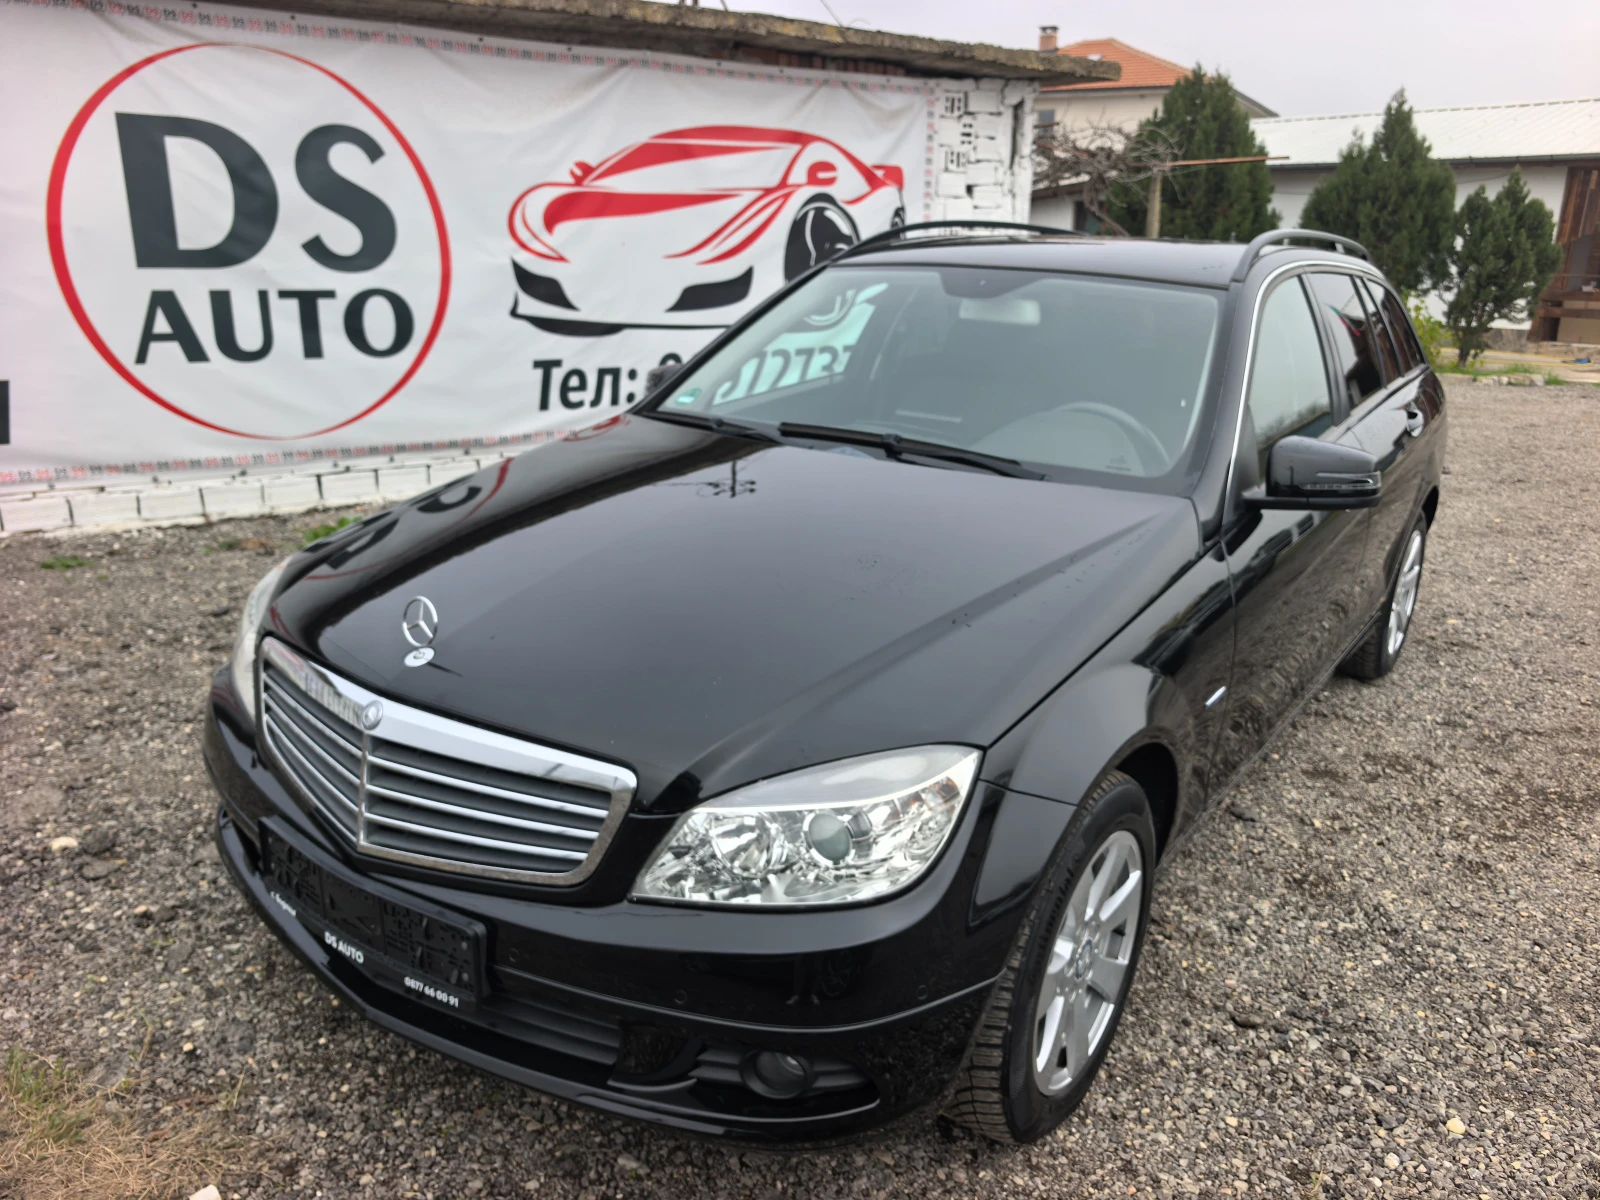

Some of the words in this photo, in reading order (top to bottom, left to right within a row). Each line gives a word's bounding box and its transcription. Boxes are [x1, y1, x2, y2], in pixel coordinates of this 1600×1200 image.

[115, 111, 397, 273] DS
[135, 288, 415, 364] AUTO
[532, 359, 637, 412] Тел:
[324, 931, 337, 948] DS
[337, 941, 364, 964] AUTO
[403, 977, 424, 992] 0877
[436, 990, 448, 1004] 00
[448, 995, 460, 1008] 91
